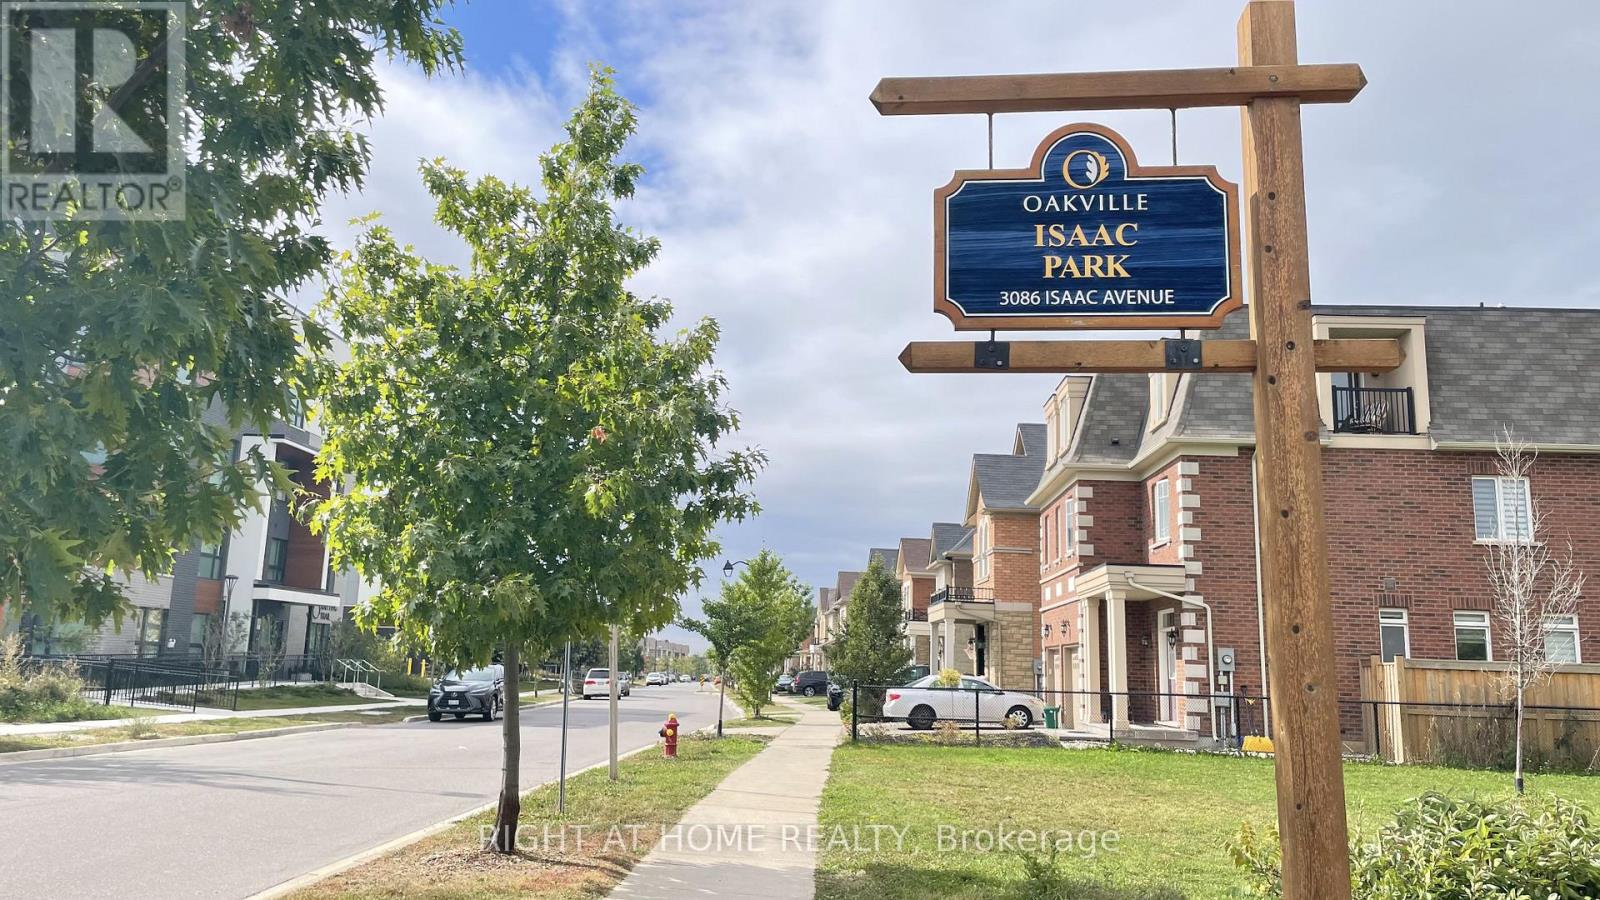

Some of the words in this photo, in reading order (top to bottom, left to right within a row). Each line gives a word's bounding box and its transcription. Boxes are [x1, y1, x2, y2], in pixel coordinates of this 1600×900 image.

[1023, 194, 1148, 212] OAKVILLE
[1033, 222, 1139, 248] ISAAC
[1042, 254, 1132, 279] PARK
[999, 291, 1041, 306] 3086
[1045, 290, 1098, 305] ISAAC
[1103, 289, 1175, 305] AVENUE
